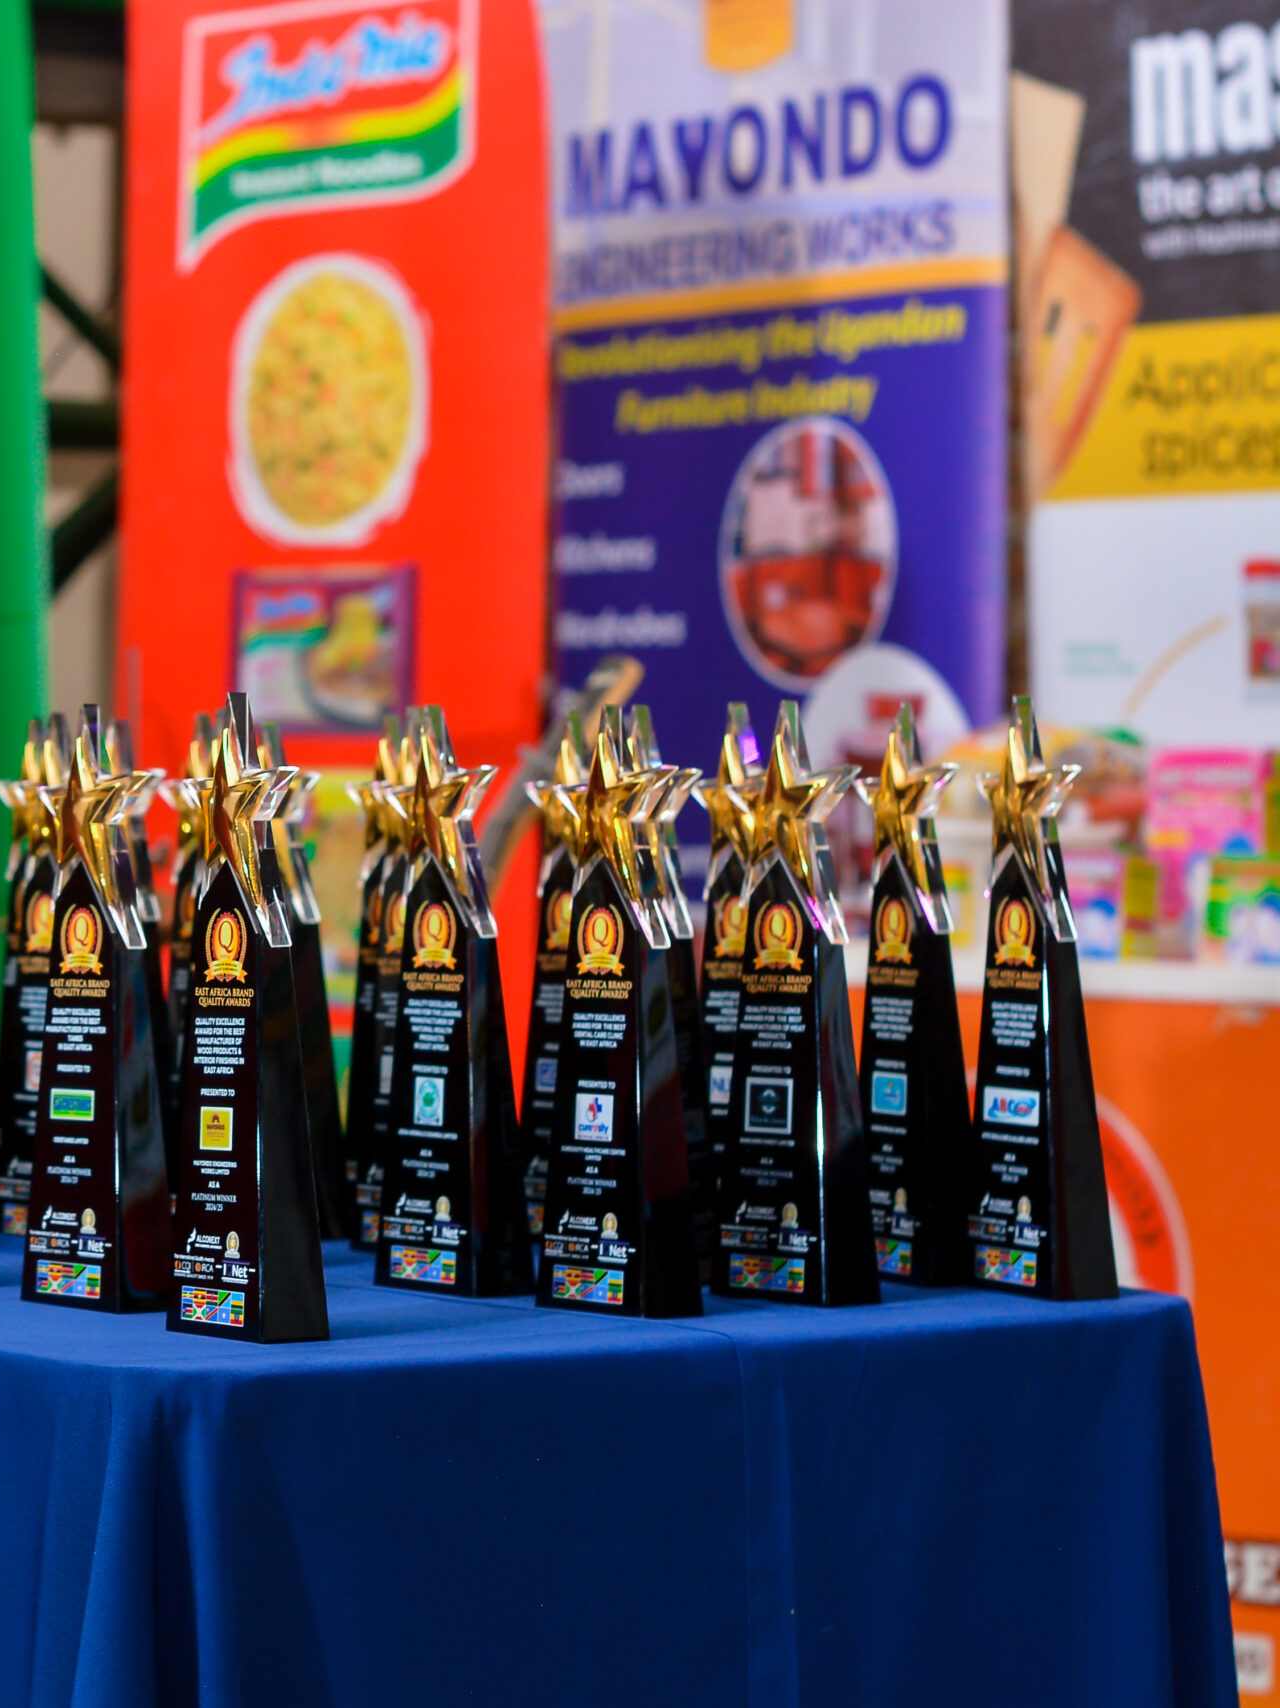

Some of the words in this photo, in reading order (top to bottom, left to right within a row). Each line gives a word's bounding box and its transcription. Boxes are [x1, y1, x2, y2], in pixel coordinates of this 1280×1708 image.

[1130, 18, 1280, 166] ma
[565, 73, 953, 218] MAYONDO
[806, 200, 956, 266] WORKS
[74, 915, 89, 947] Q
[426, 912, 443, 942] Q
[591, 914, 609, 947] Q
[770, 911, 787, 943] Q
[218, 920, 234, 953] Q
[50, 978, 64, 987] EAST
[65, 978, 87, 988] AFRICA
[88, 979, 110, 988] BRAND
[566, 978, 582, 988] EAST
[582, 979, 607, 989] AFRICA
[607, 980, 633, 990] BRAND
[759, 974, 785, 984] AFRICA
[53, 988, 81, 998] QUALITY
[81, 988, 107, 997] AWARDS
[195, 987, 209, 996] EAST
[209, 988, 232, 997] AFRICA
[232, 988, 254, 998] BRAND
[570, 988, 600, 999] QUALITY
[600, 989, 629, 1000] AWARDS
[198, 996, 225, 1008] QUALITY
[225, 997, 251, 1007] AWARDS
[195, 1017, 215, 1025] QUALITY
[215, 1017, 245, 1026] EXCELLENCE
[213, 1027, 223, 1035] FOR
[223, 1027, 232, 1035] THE
[233, 1027, 245, 1036] BEST
[203, 1066, 216, 1074] EAST
[216, 1066, 234, 1075] AFRICA
[228, 1088, 235, 1097] TO
[191, 1192, 215, 1201] PLATINUM
[216, 1193, 237, 1203] WINNER
